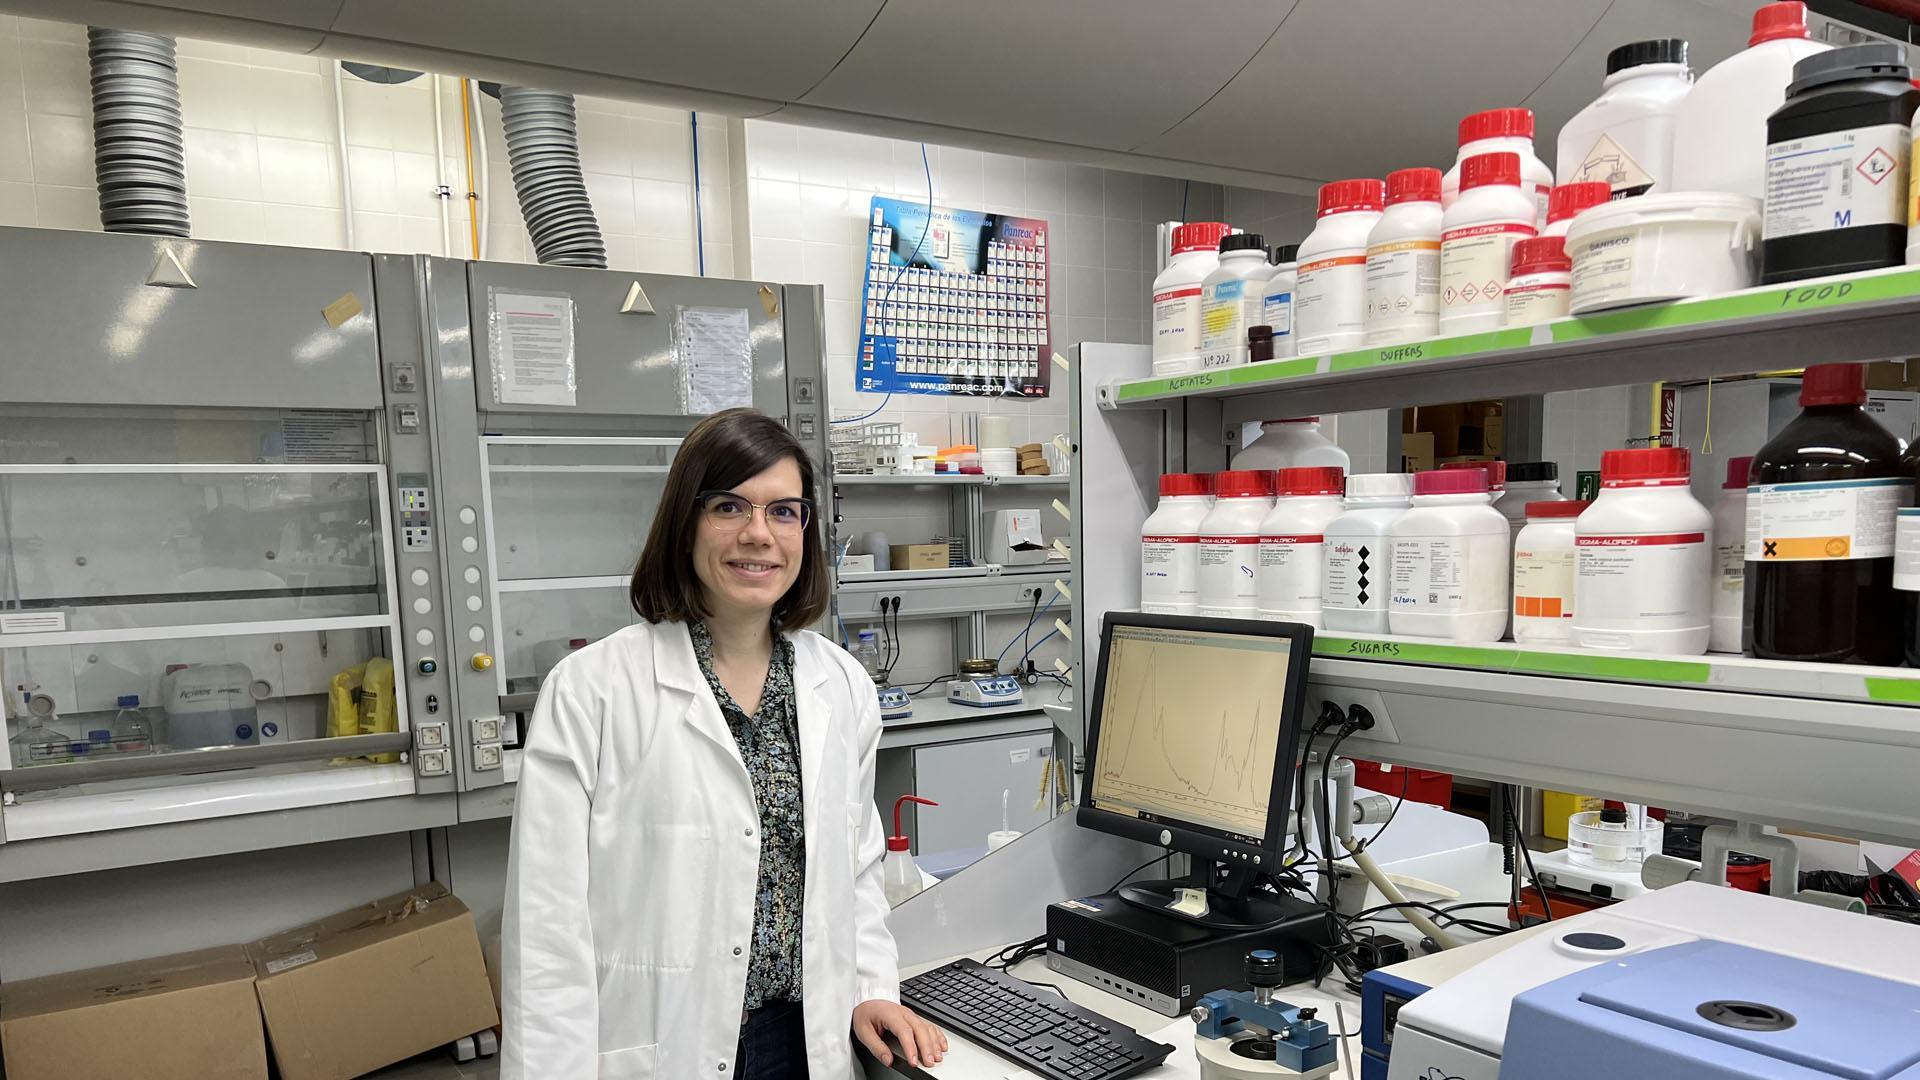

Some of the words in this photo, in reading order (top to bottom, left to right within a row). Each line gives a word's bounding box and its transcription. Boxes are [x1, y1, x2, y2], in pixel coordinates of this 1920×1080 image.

[1835, 210, 1851, 228] M
[1004, 223, 1033, 240] Panreac
[1781, 282, 1853, 307] FOOD
[1216, 353, 1230, 365] 222
[1380, 345, 1423, 361] BUFFERS
[910, 381, 1004, 392] www.panreac.com
[1169, 375, 1213, 390] ACETATES
[1348, 641, 1401, 656] SUGARS
